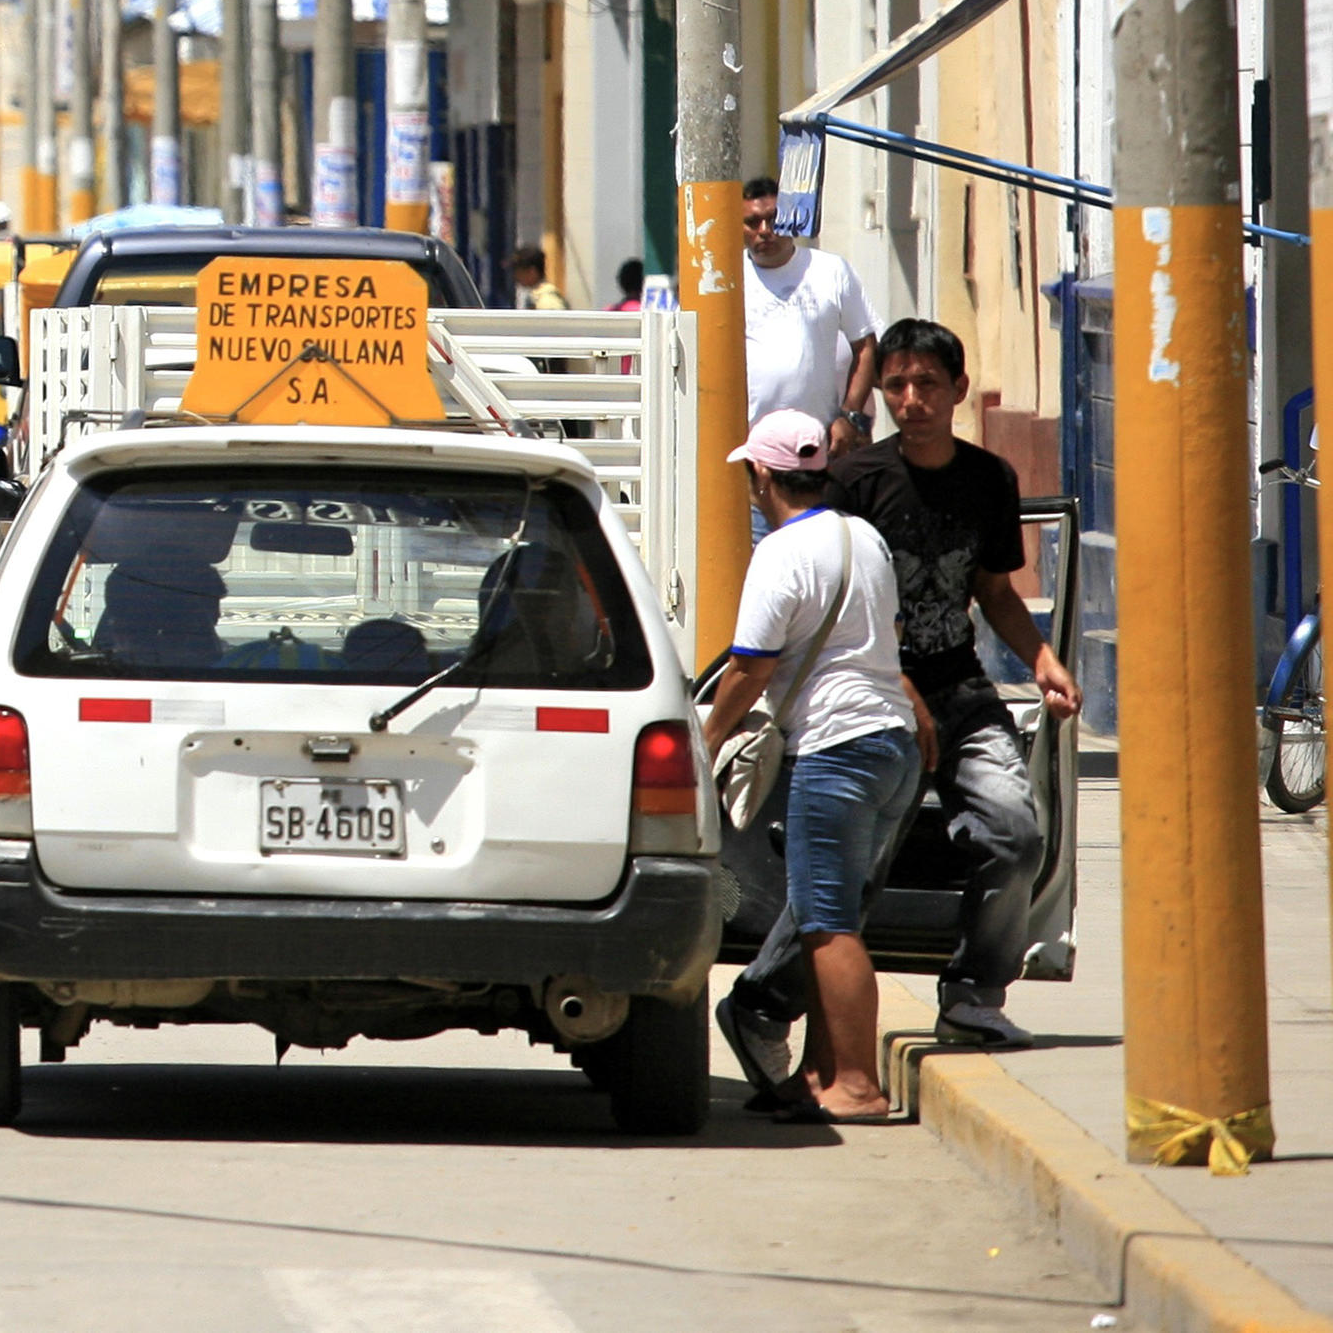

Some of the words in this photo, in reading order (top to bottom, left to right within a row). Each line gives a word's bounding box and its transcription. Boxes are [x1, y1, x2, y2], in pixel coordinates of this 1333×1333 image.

[218, 272, 378, 299] EMPRESA
[209, 302, 235, 327] DE
[247, 303, 417, 330] TRANSPORTES
[209, 336, 291, 362] NUEVO
[300, 338, 405, 366] SULLANA
[266, 805, 395, 840] SB-4609
